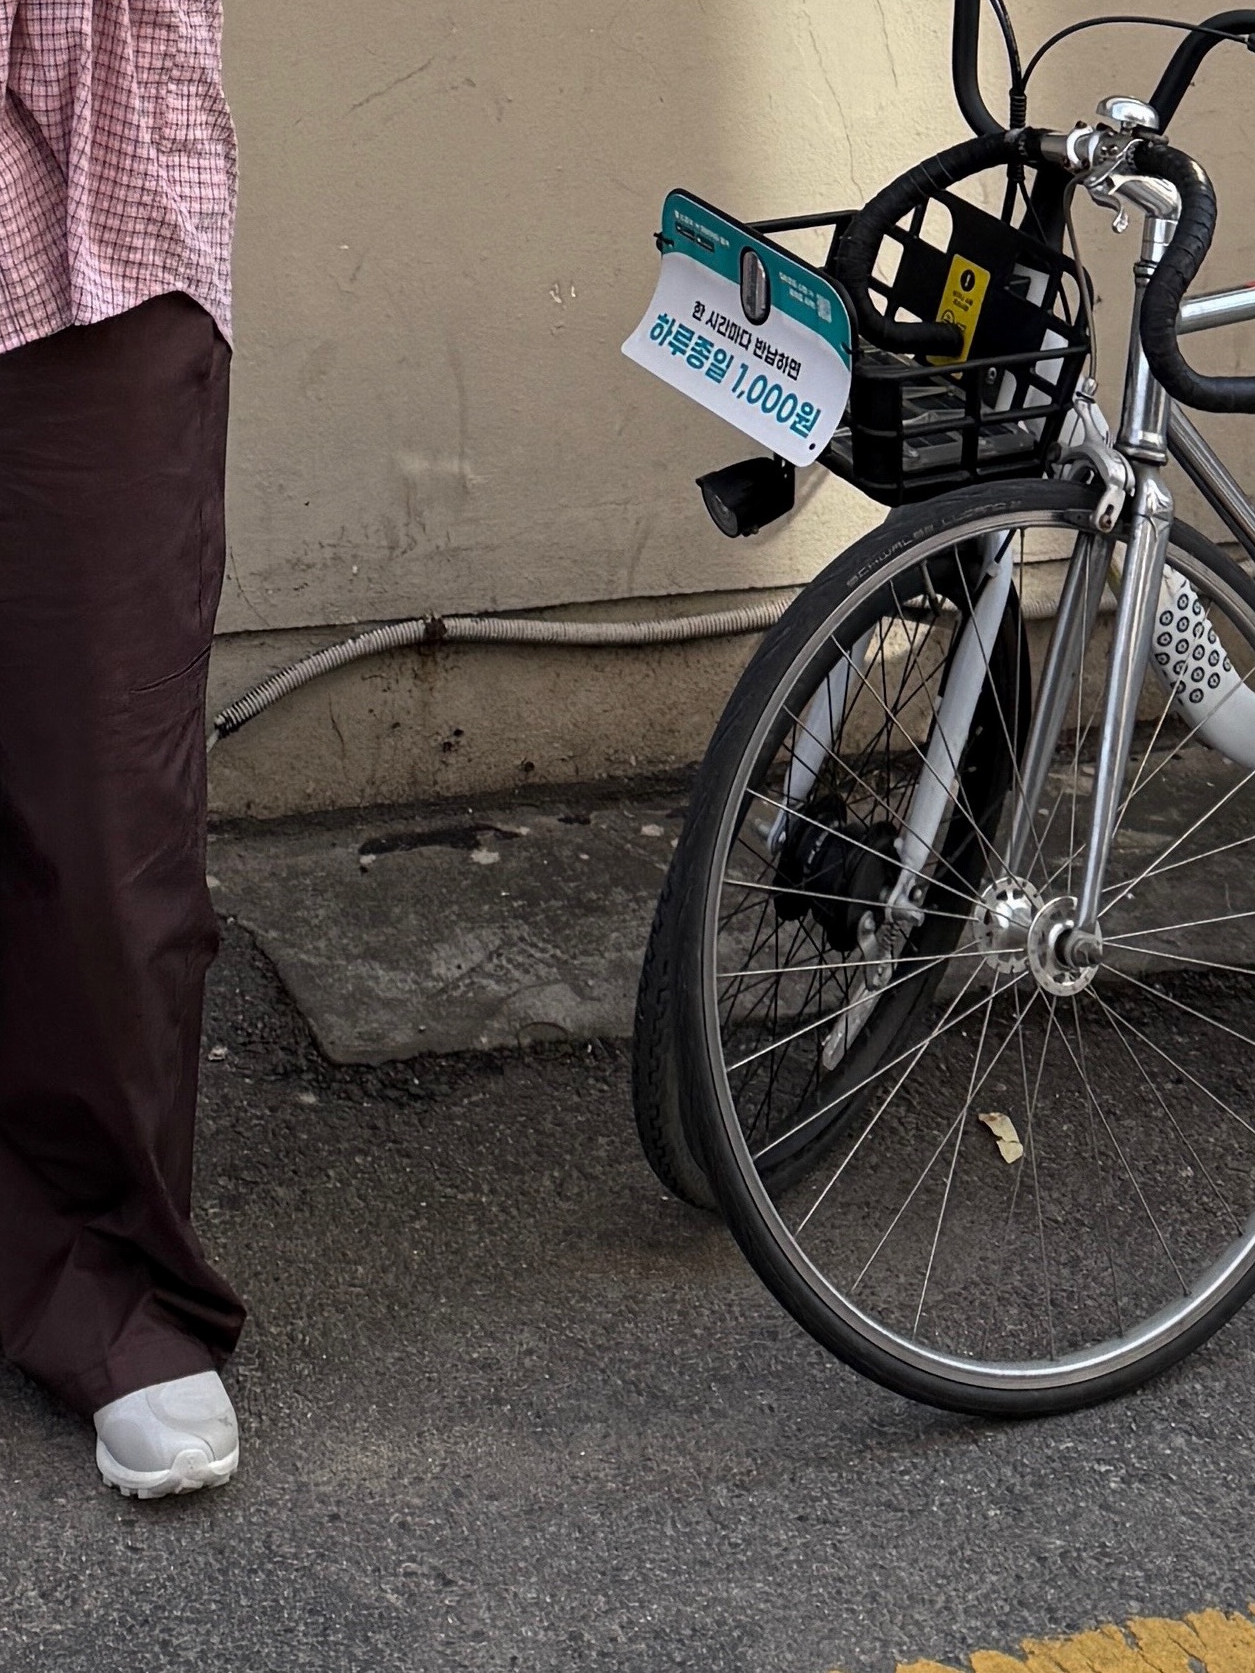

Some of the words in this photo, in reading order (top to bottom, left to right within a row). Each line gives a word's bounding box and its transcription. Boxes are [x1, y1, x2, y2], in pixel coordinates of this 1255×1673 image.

[649, 312, 735, 384] 하루종일
[730, 362, 822, 439] 1,000원
[691, 300, 706, 322] 한
[705, 310, 753, 351] 시간마다
[752, 337, 802, 381] 반납하면
